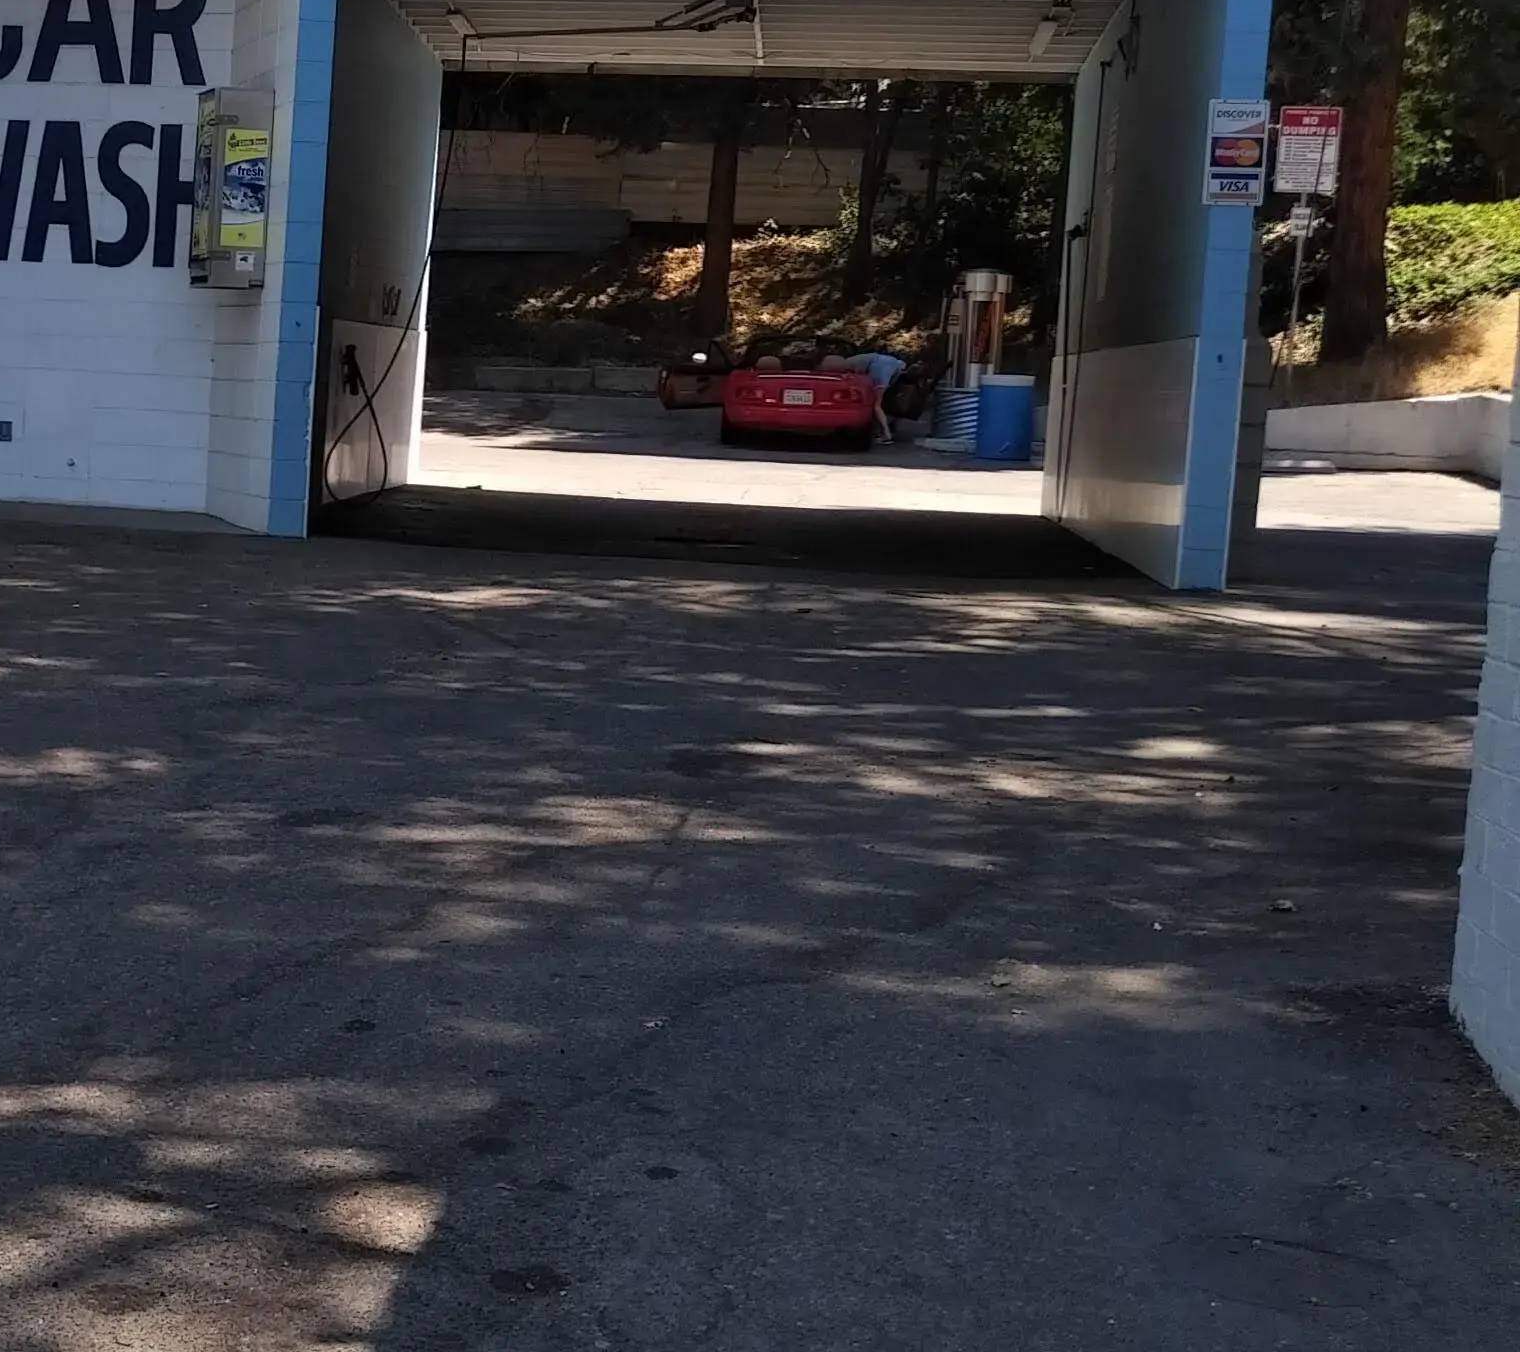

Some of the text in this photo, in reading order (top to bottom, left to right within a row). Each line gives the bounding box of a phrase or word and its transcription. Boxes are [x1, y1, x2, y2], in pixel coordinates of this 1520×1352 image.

[1216, 110, 1262, 119] DISCOVER
[237, 164, 265, 178] fresh
[1219, 180, 1249, 192] VISA
